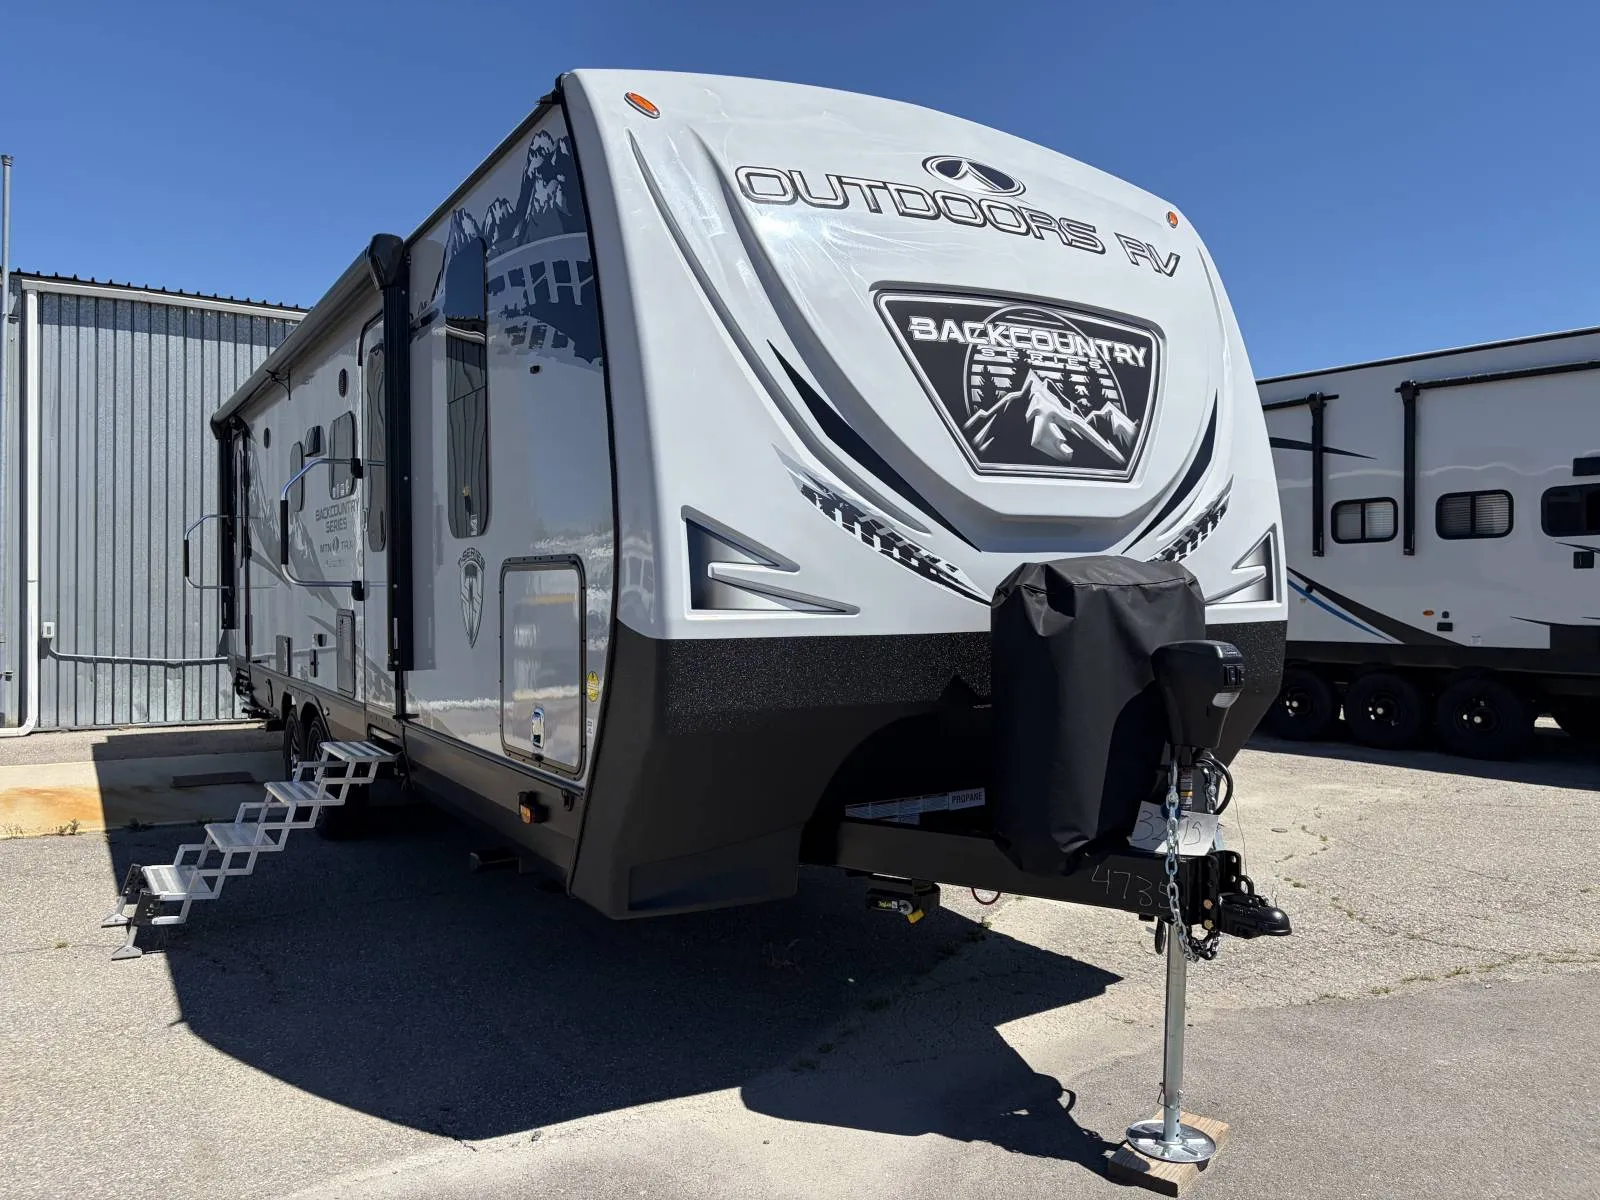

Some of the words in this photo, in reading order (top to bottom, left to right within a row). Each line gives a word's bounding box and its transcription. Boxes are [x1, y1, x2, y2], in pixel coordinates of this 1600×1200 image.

[735, 165, 1106, 255] OUTDOORS
[1115, 232, 1181, 277] RV
[908, 315, 1148, 368] BACKCOUNTRY
[980, 348, 1102, 370] SERIES
[315, 498, 359, 522] BACKCOUNTRY
[325, 517, 348, 534] SERIES
[951, 791, 983, 804] PROPANE
